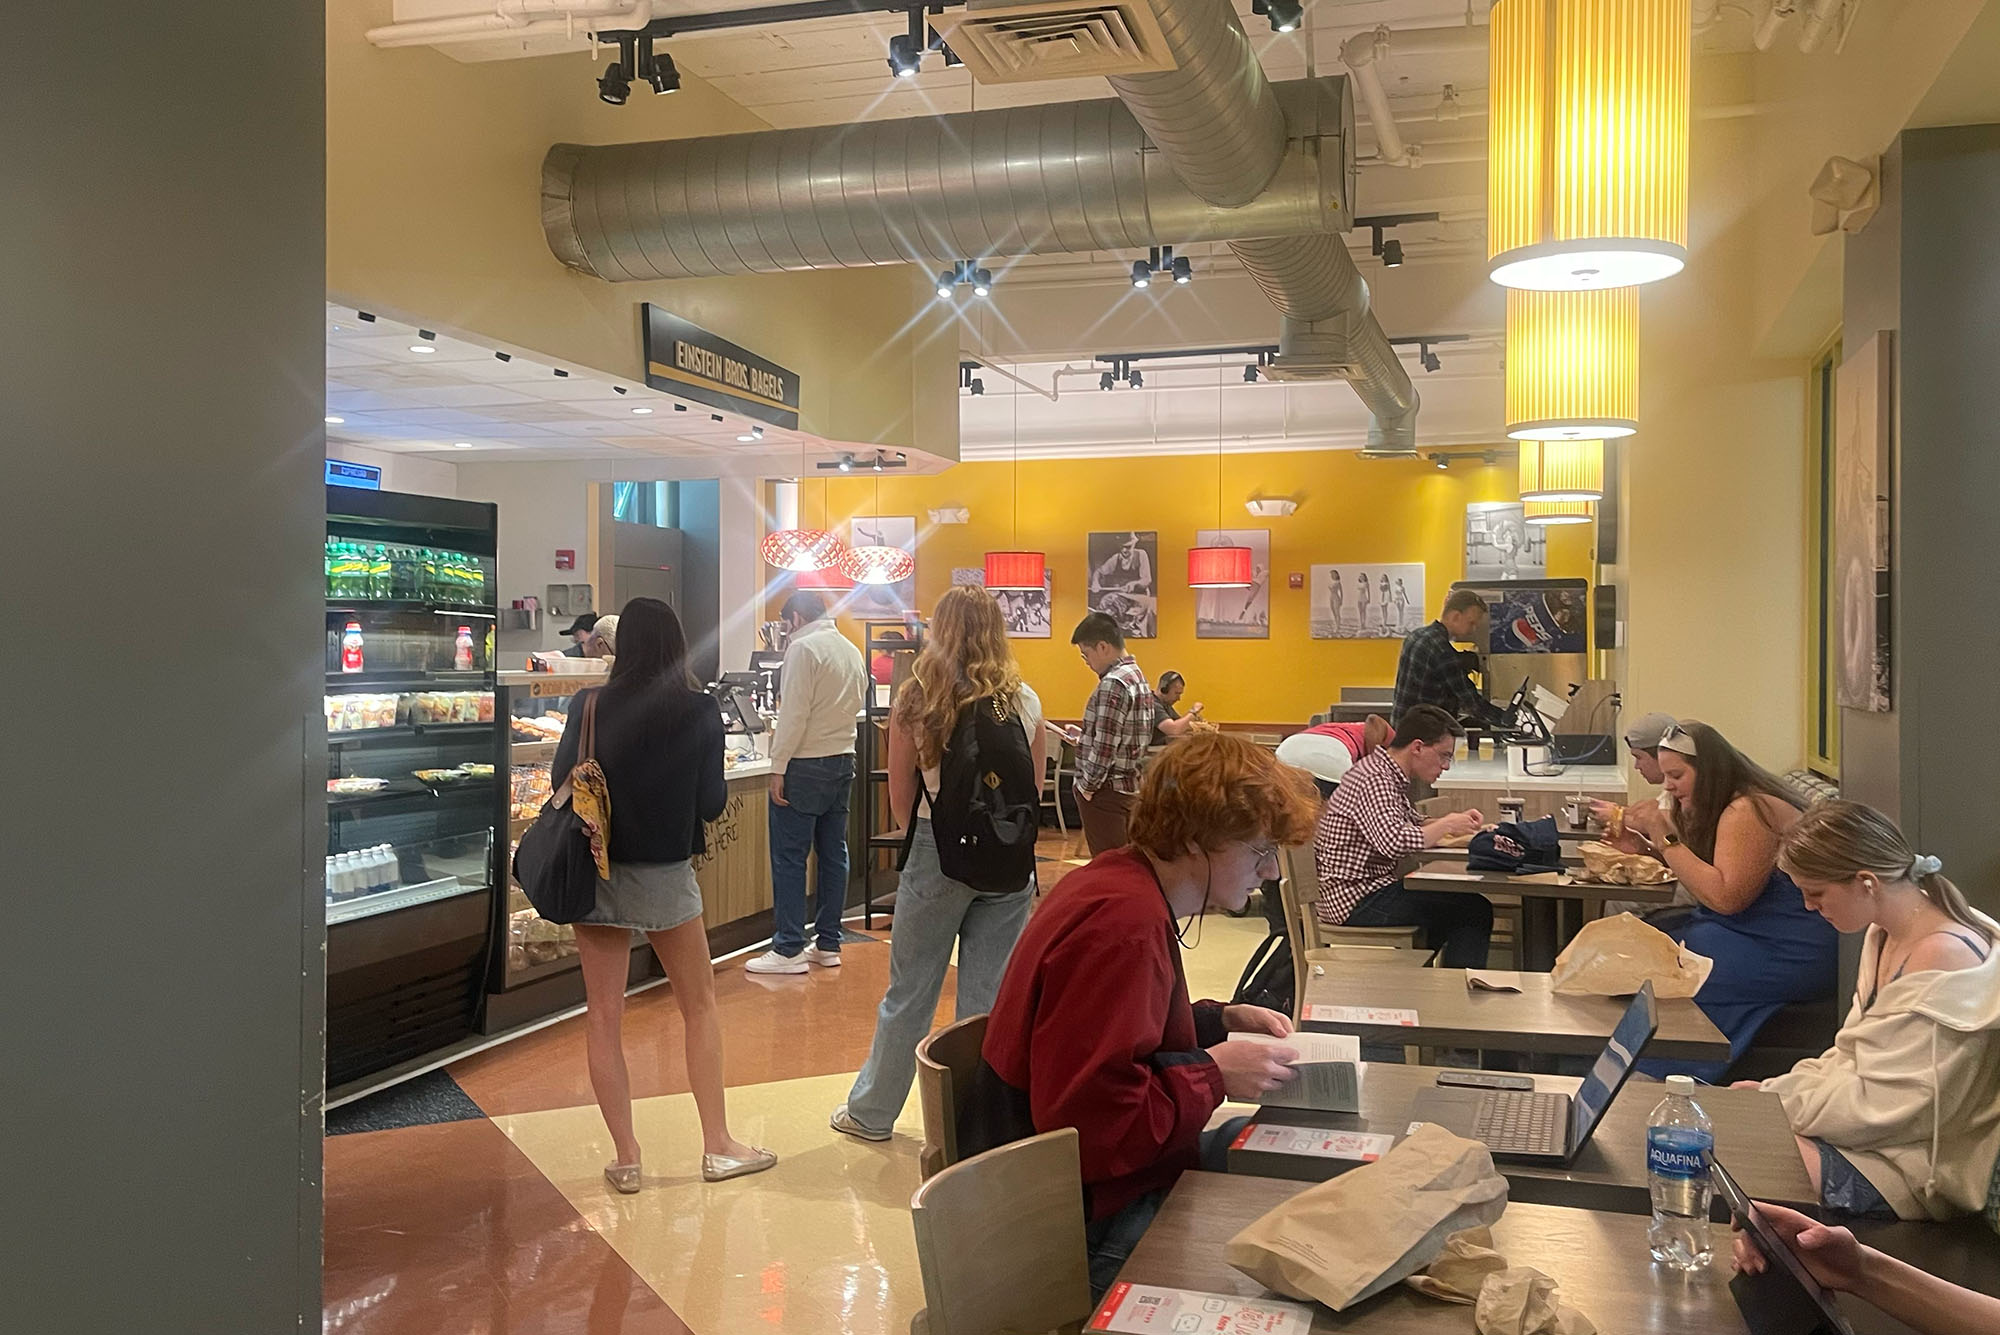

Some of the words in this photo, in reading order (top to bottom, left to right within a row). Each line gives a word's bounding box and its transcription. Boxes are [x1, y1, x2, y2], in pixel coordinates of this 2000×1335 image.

[677, 340, 723, 379] EINSTEIN
[724, 357, 750, 390] BROS.
[751, 367, 784, 401] BAGELS
[1524, 605, 1553, 642] PEPS
[714, 822, 738, 854] HERE
[1650, 1148, 1702, 1169] AQUAFINA
